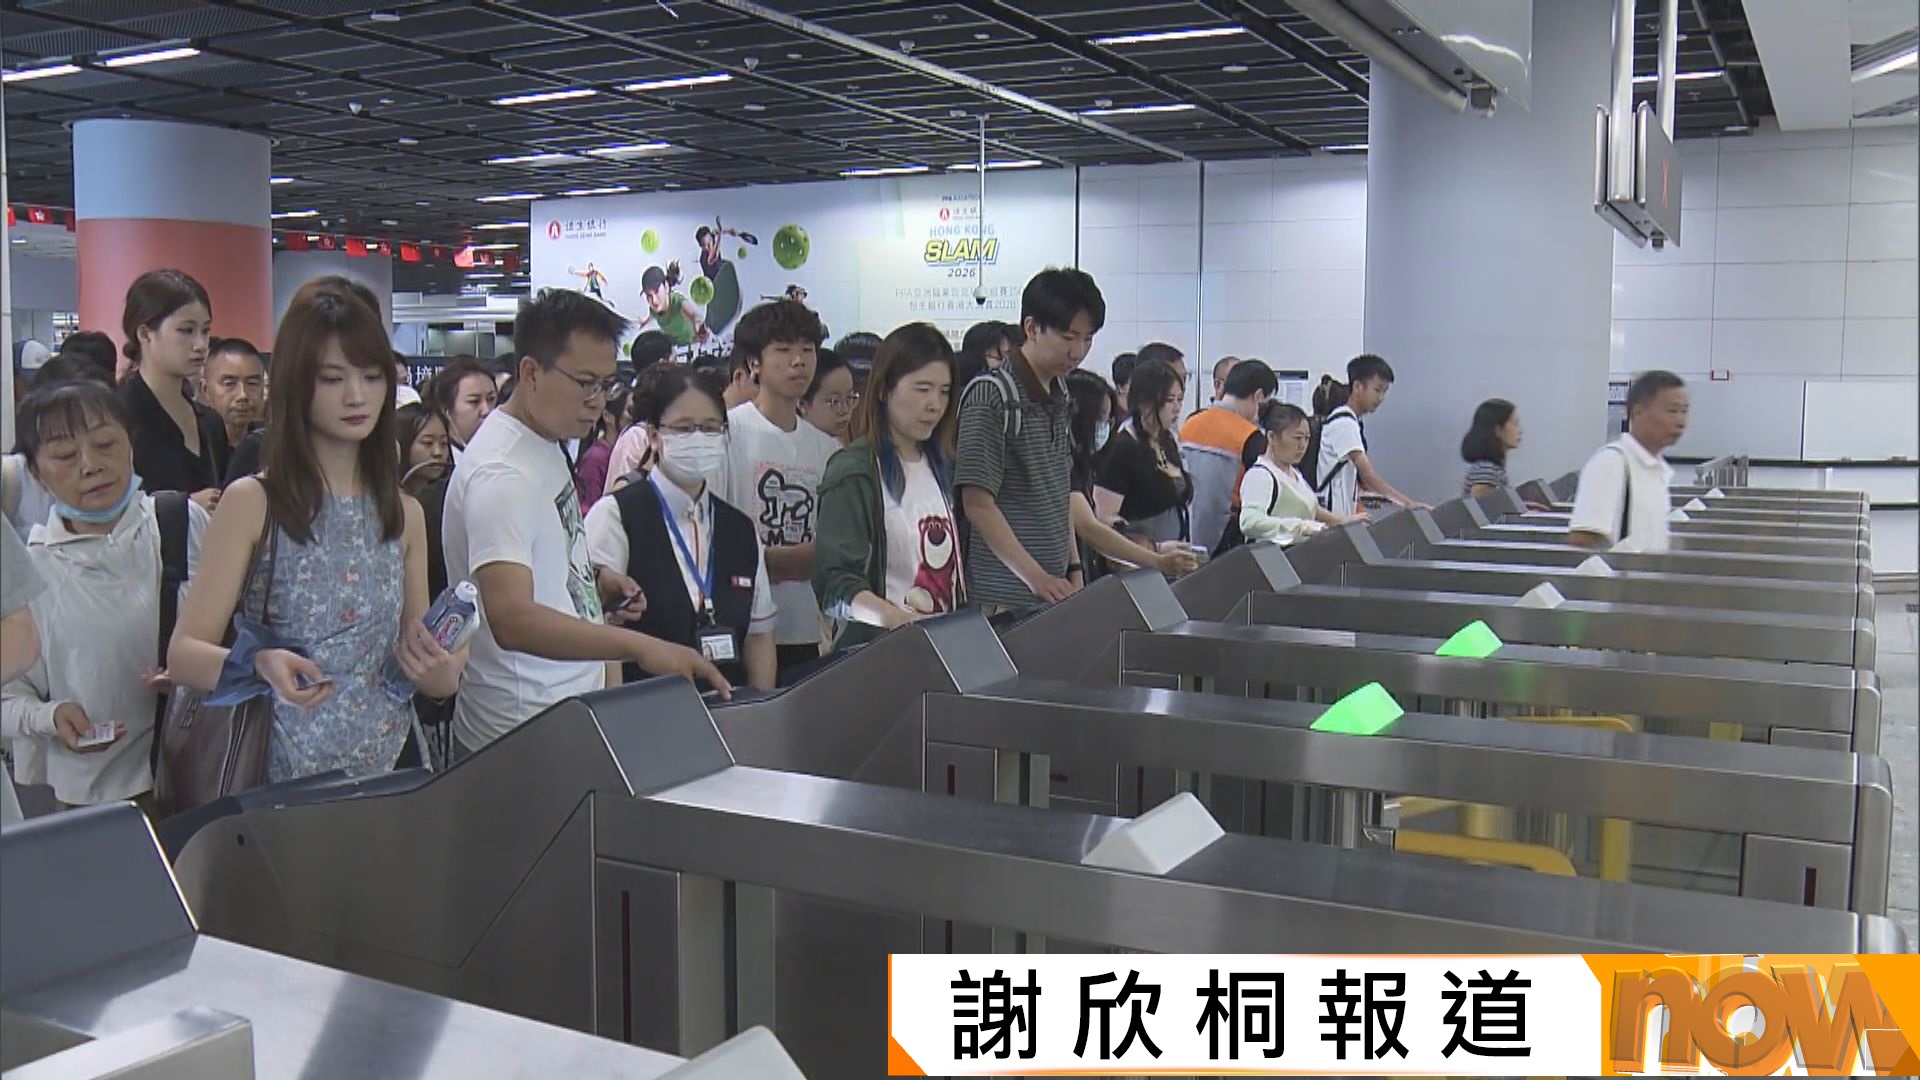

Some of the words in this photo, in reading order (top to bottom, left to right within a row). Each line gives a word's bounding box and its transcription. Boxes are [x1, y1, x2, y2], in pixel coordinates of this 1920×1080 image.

[930, 226, 961, 237] HONG
[964, 224, 995, 236] KONG
[924, 238, 999, 266] SLAM
[947, 268, 976, 277] 2026
